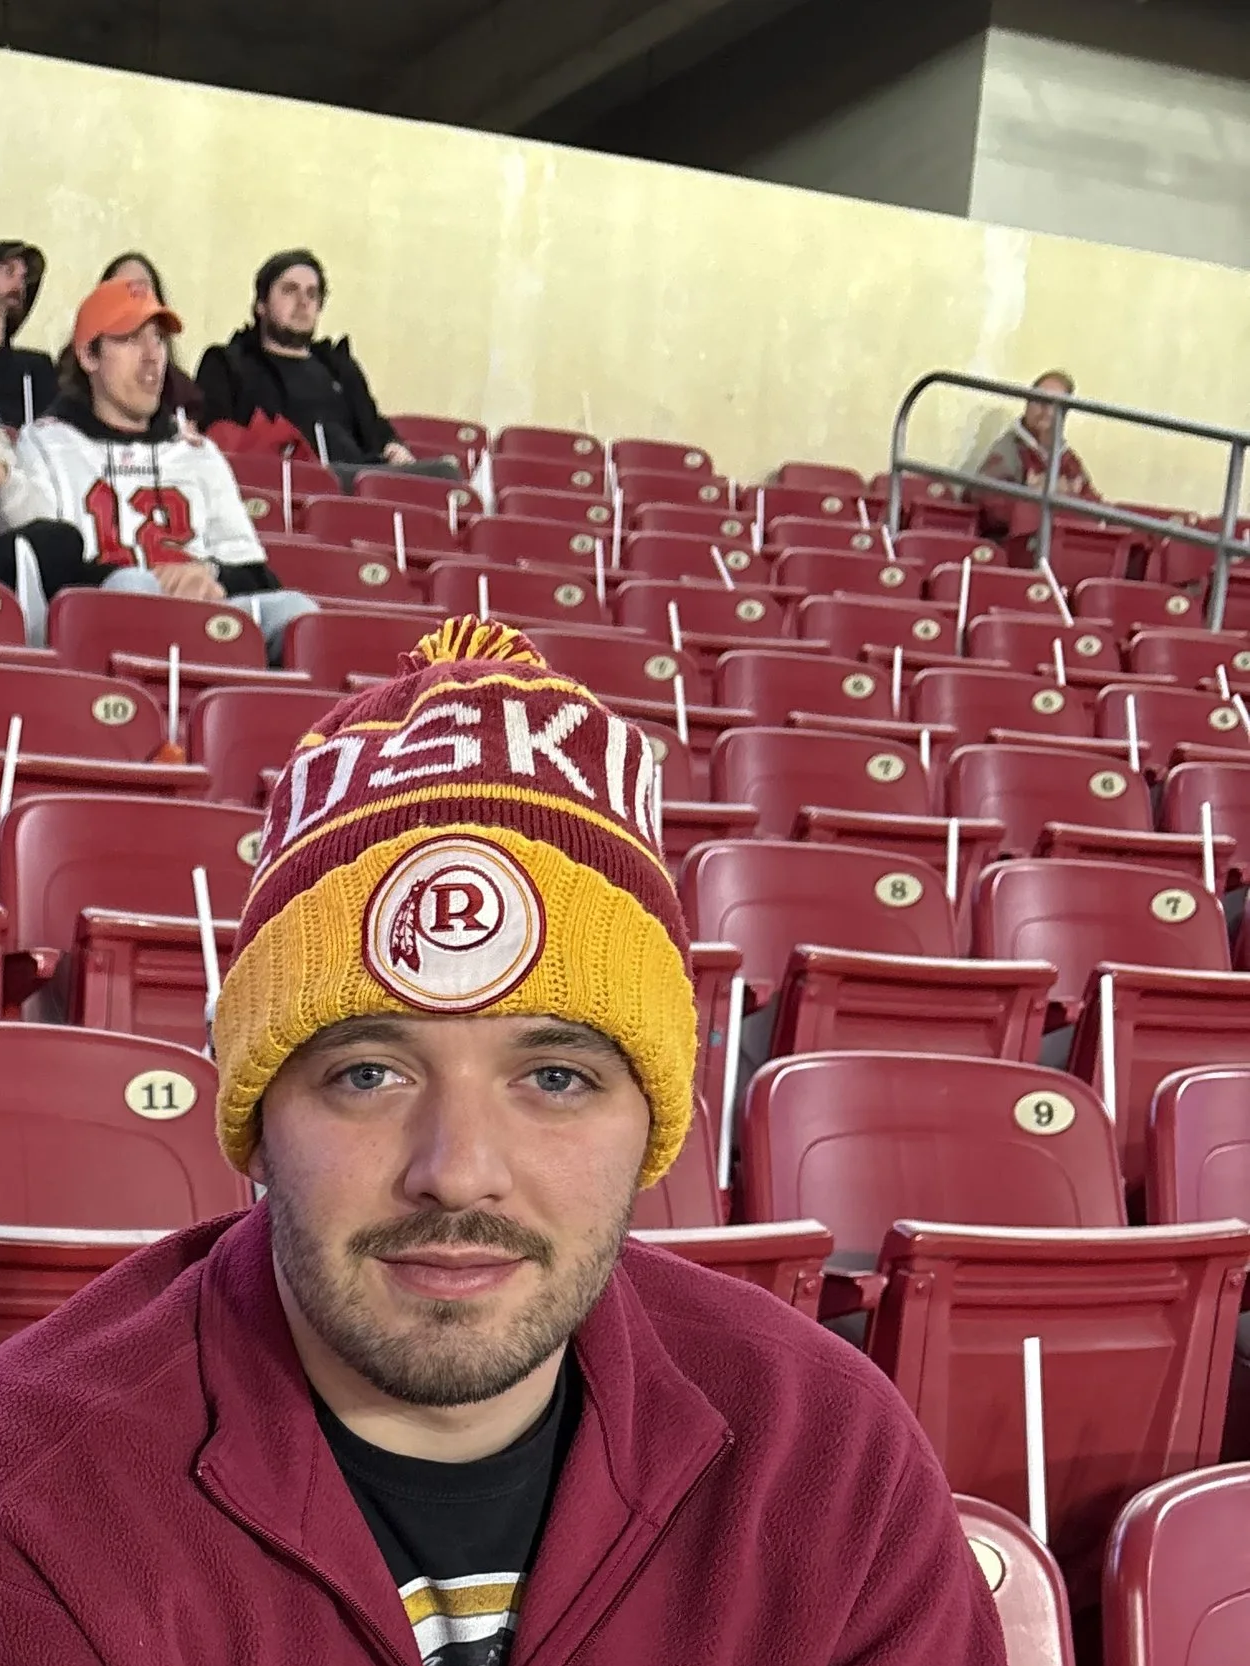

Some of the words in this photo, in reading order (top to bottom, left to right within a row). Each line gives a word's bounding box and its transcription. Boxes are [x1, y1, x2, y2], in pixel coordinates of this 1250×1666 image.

[84, 479, 196, 570] 12
[103, 702, 129, 720] 10
[878, 760, 893, 776] 7
[253, 699, 658, 870] DSKI
[1101, 776, 1115, 792] 6
[890, 880, 908, 900] 8
[430, 883, 489, 932] R
[1165, 896, 1182, 915] 7
[141, 1082, 178, 1110] 11
[1034, 1100, 1055, 1127] 9
